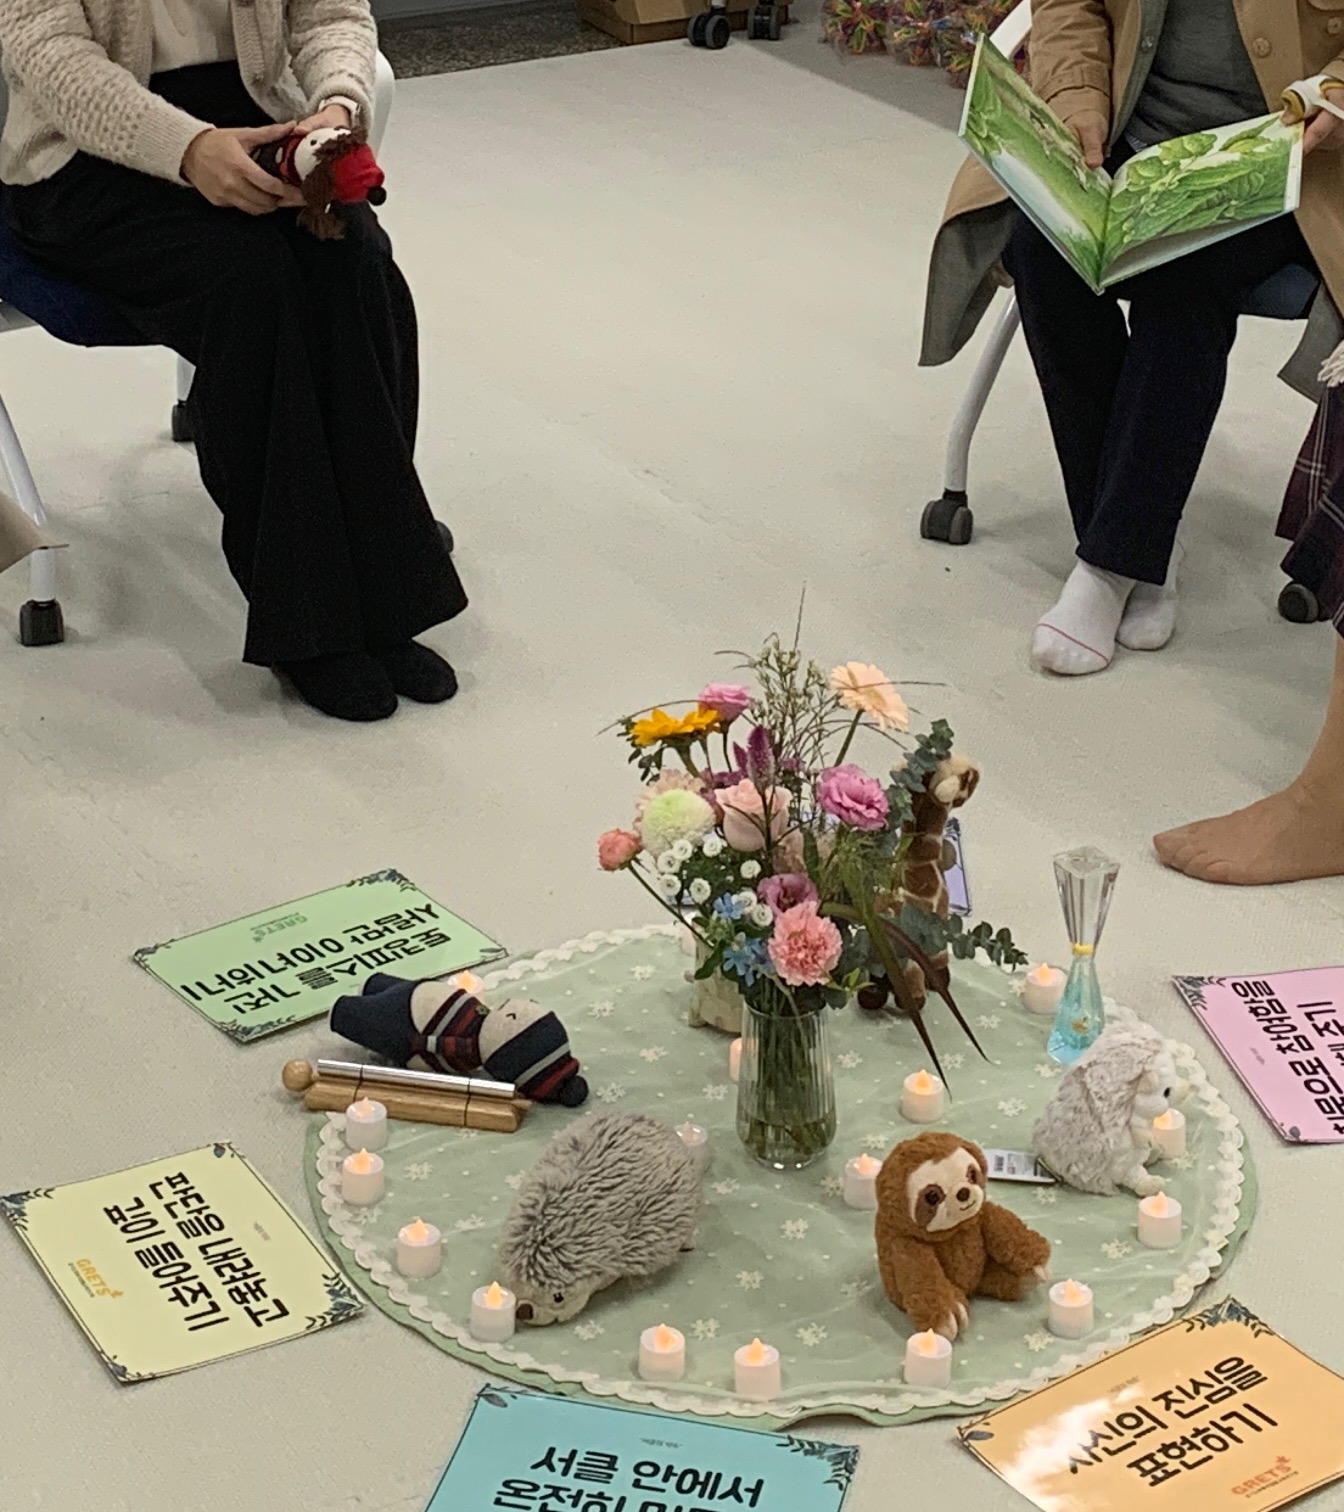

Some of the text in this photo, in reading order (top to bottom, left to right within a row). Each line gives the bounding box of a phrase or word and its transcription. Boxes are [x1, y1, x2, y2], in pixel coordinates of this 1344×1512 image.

[180, 903, 441, 1002] 사람만 이야기하기
[224, 927, 453, 1015] 토킹피스를 가진
[1231, 980, 1314, 1055] 참여함을
[75, 1258, 112, 1297] GRETS
[103, 1197, 230, 1332] 깊이 들어주기
[149, 1171, 290, 1328] 판단을 내려놓고
[1151, 1356, 1269, 1419] 진심을
[530, 1446, 765, 1508] 서클 안에서
[1127, 1403, 1278, 1488] 표현하기
[1231, 1461, 1287, 1498] GRETS
